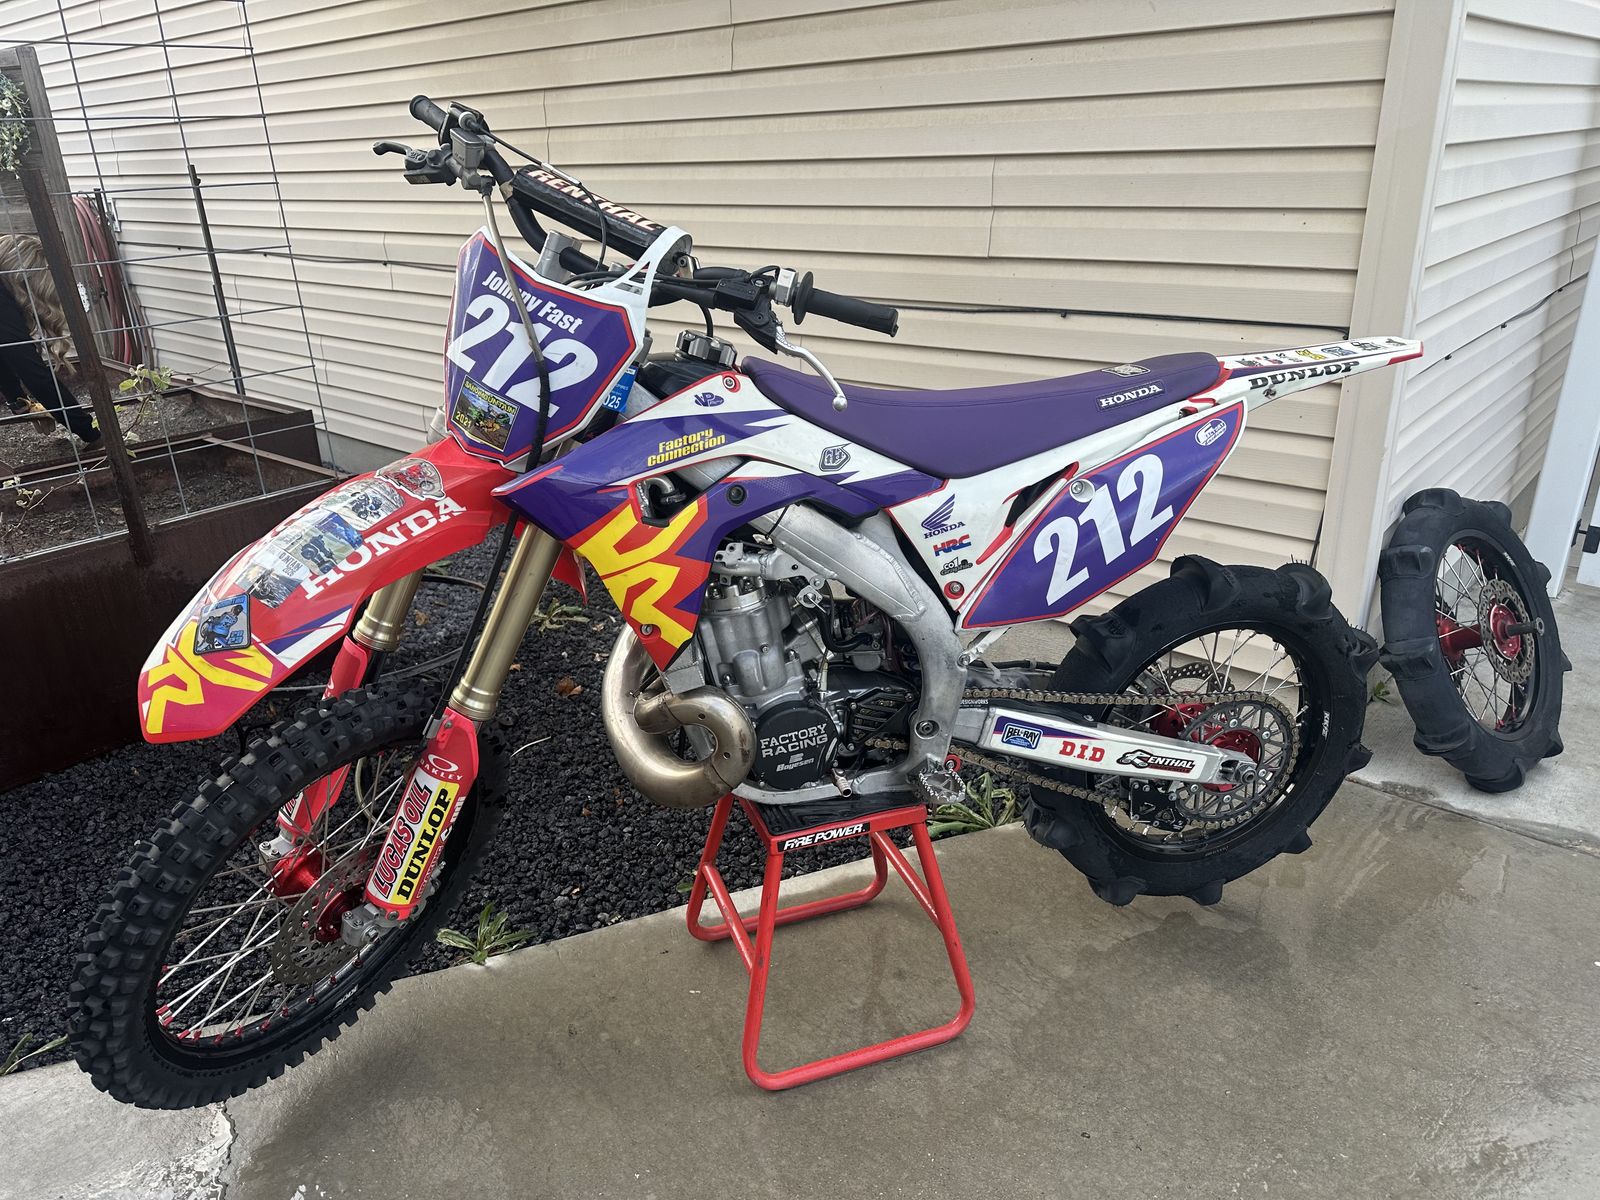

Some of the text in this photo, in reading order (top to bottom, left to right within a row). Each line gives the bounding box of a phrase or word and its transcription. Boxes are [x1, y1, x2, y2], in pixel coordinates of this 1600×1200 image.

[527, 169, 658, 231] RENTHAL
[482, 271, 583, 334] Johny Fast
[446, 294, 598, 418] 212
[1248, 361, 1360, 389] DUNLOP
[1100, 385, 1162, 407] HONDA
[658, 428, 713, 453] Factory
[924, 521, 966, 539] HONDA
[1034, 454, 1174, 607] 212
[300, 497, 467, 600] HONDA
[933, 534, 971, 557] HRC
[760, 723, 827, 749] FACTORY
[761, 734, 828, 758] RACING
[420, 758, 463, 780] OAKLEY
[372, 816, 415, 899] LUCAS
[403, 778, 432, 824] OIL
[397, 788, 451, 900] DUNLOP
